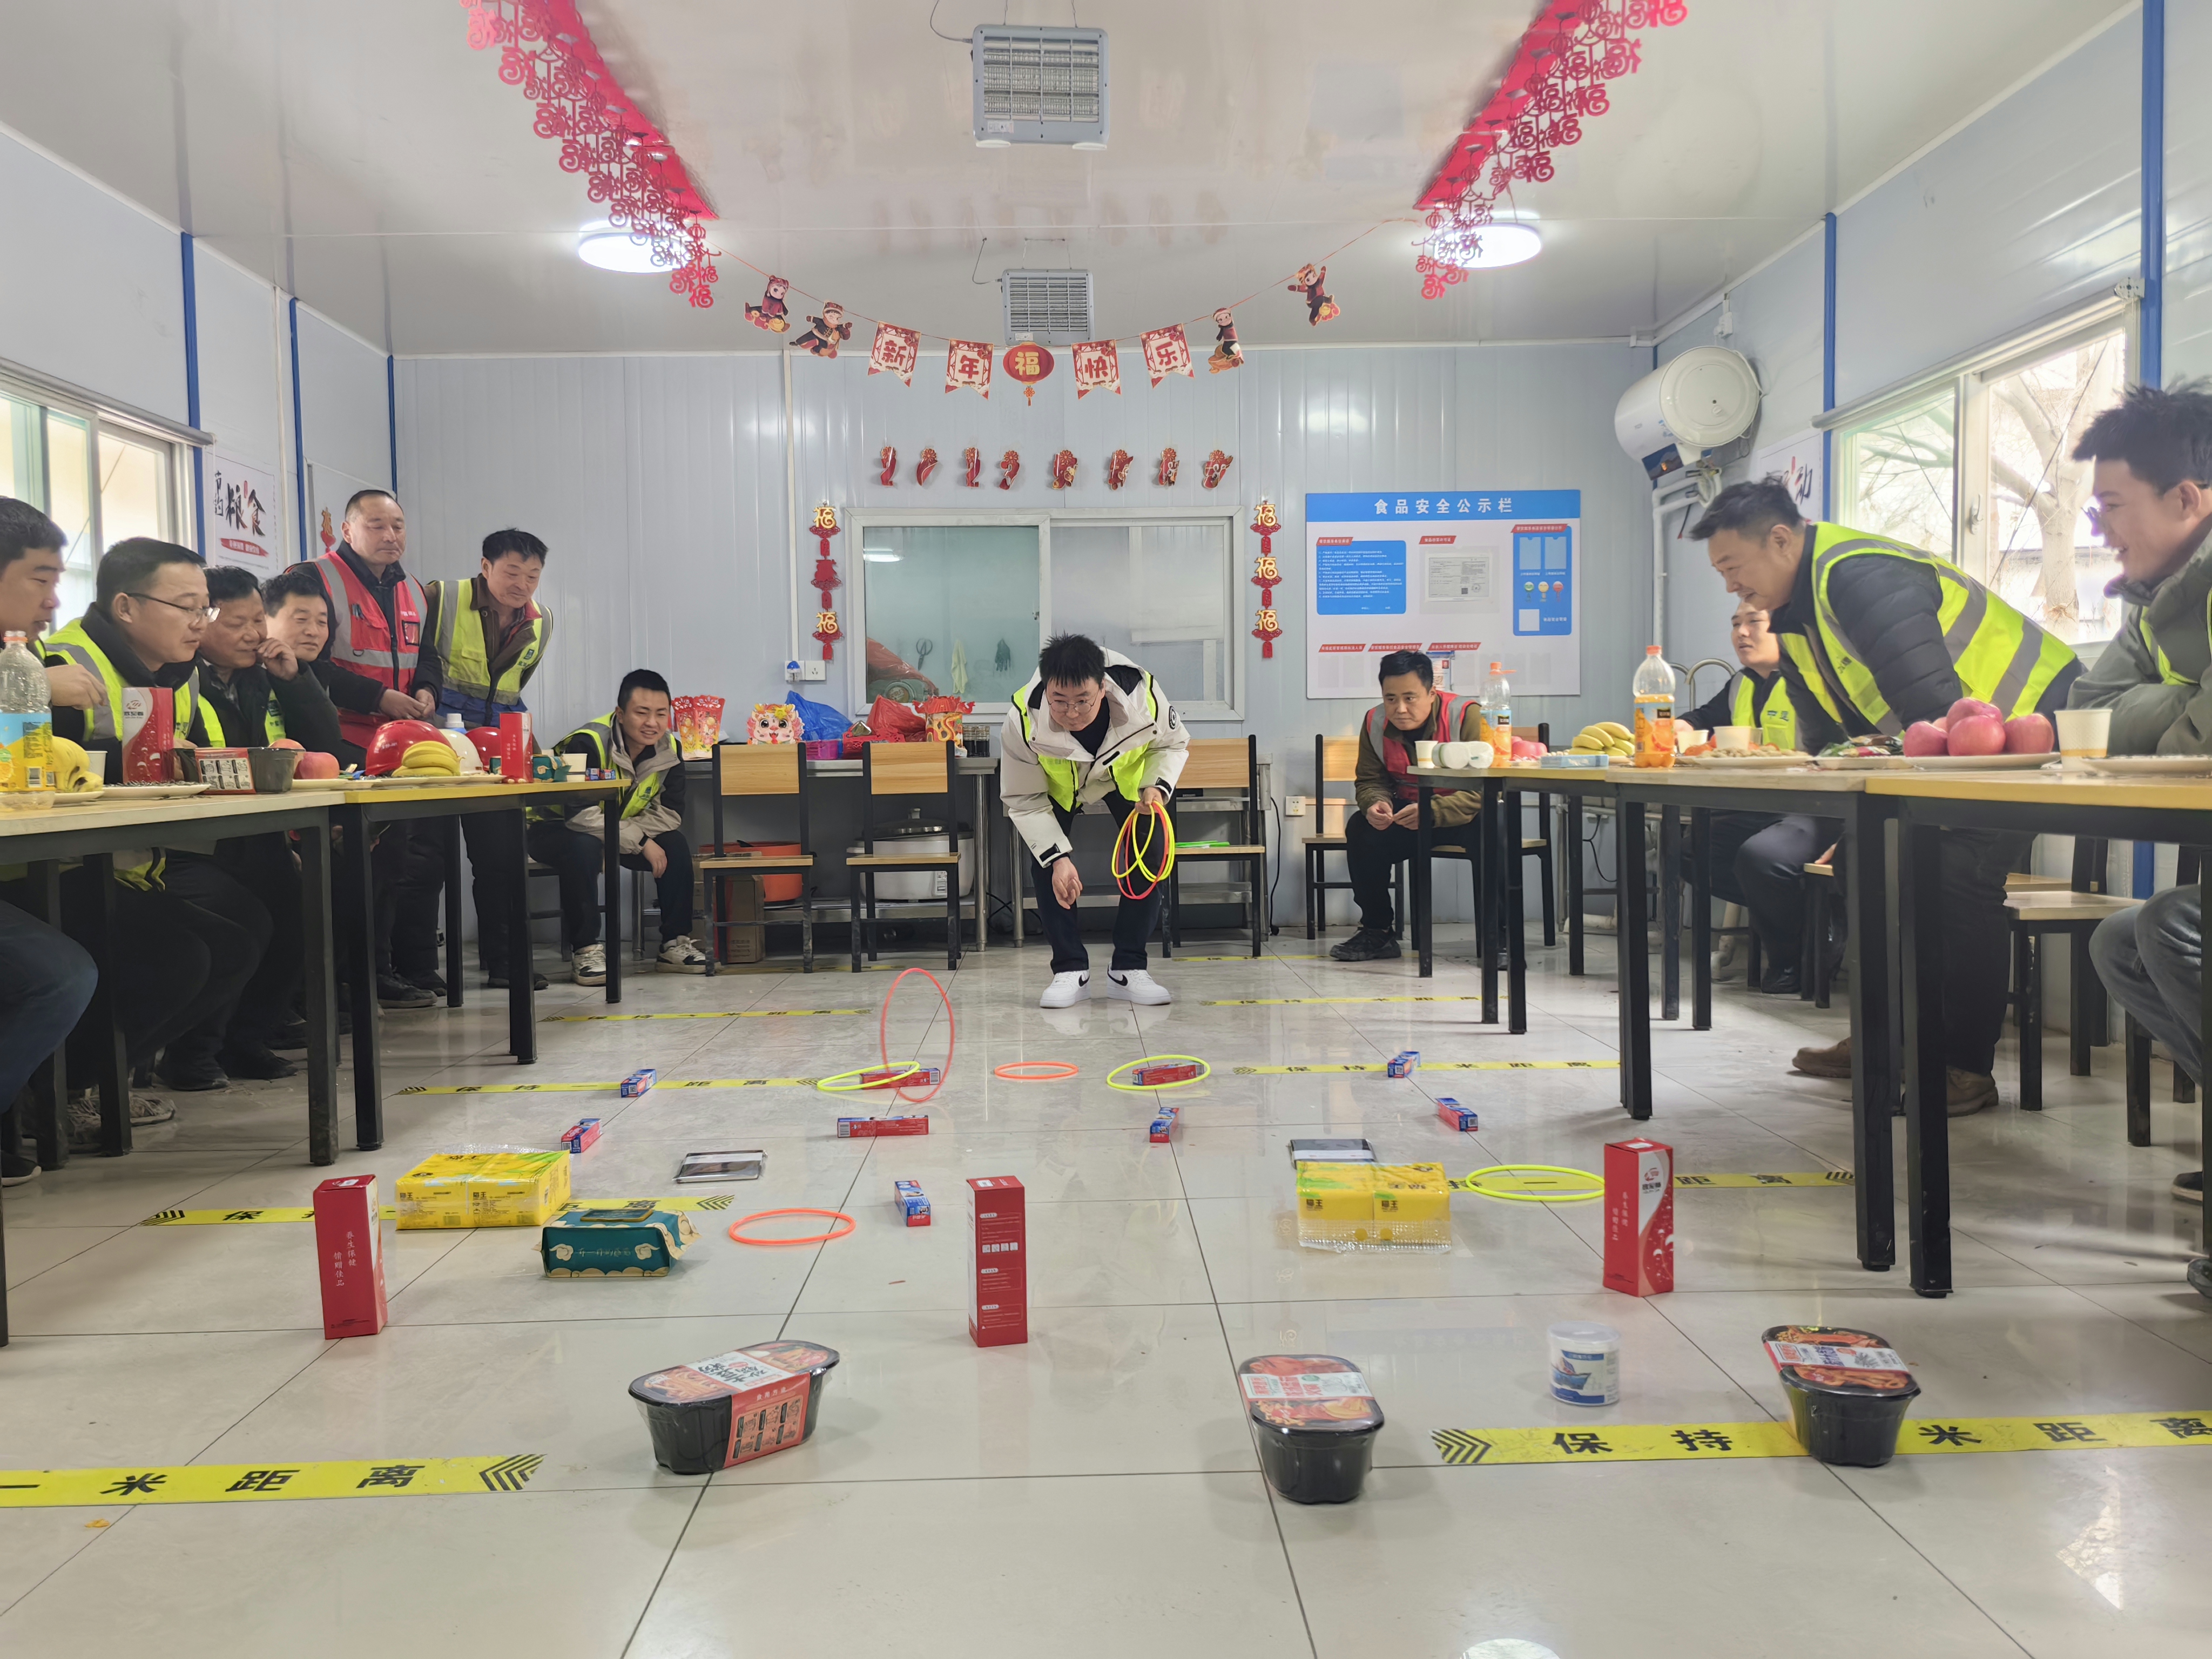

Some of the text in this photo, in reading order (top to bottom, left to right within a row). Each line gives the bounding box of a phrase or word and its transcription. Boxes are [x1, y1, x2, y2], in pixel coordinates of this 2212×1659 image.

[814, 506, 836, 529] 福
[1255, 504, 1277, 527] 福
[1374, 498, 1513, 514] 食品安全公示栏
[1255, 557, 1278, 579] 福
[816, 612, 838, 635] 福
[1255, 609, 1278, 632] 福
